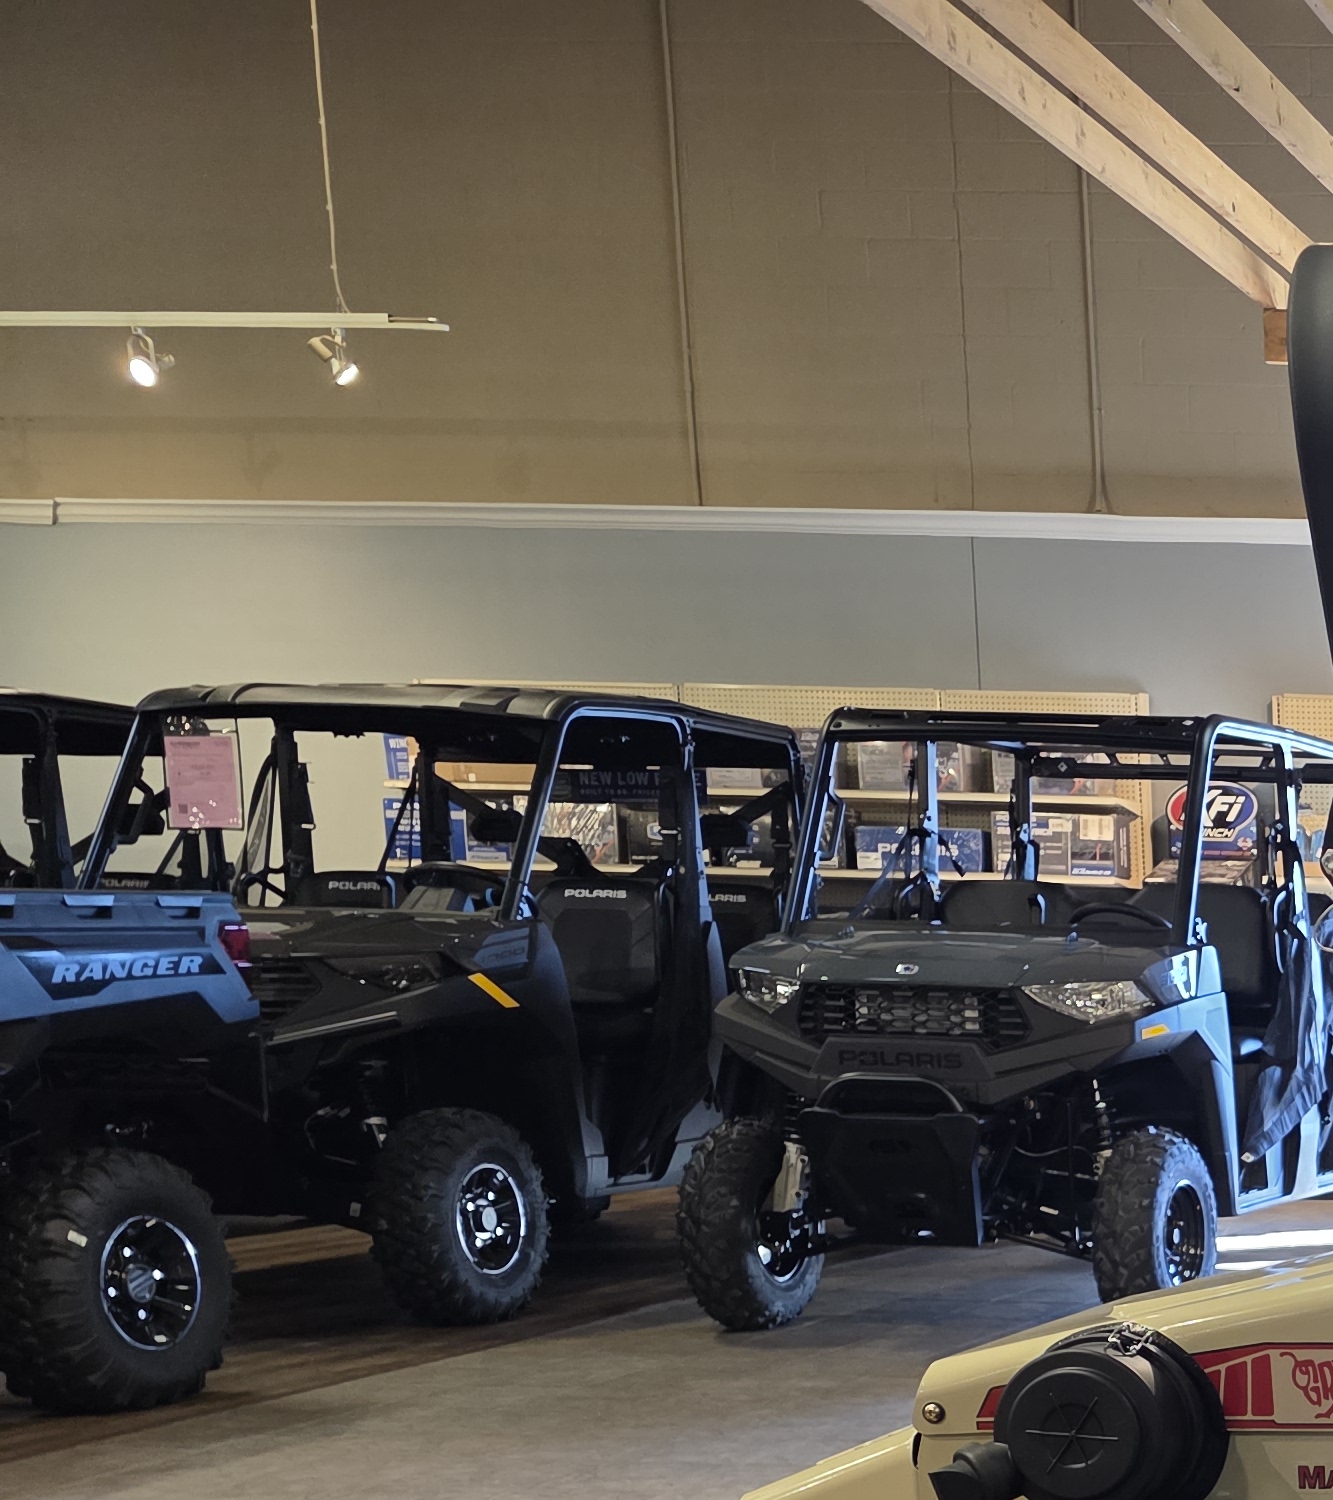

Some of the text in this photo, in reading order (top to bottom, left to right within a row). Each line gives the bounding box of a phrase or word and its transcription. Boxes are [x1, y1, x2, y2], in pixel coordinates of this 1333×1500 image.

[1202, 826, 1234, 838] INCH
[564, 888, 627, 899] POLARIS
[51, 955, 203, 984] RANGER
[839, 1049, 963, 1069] POLARIS
